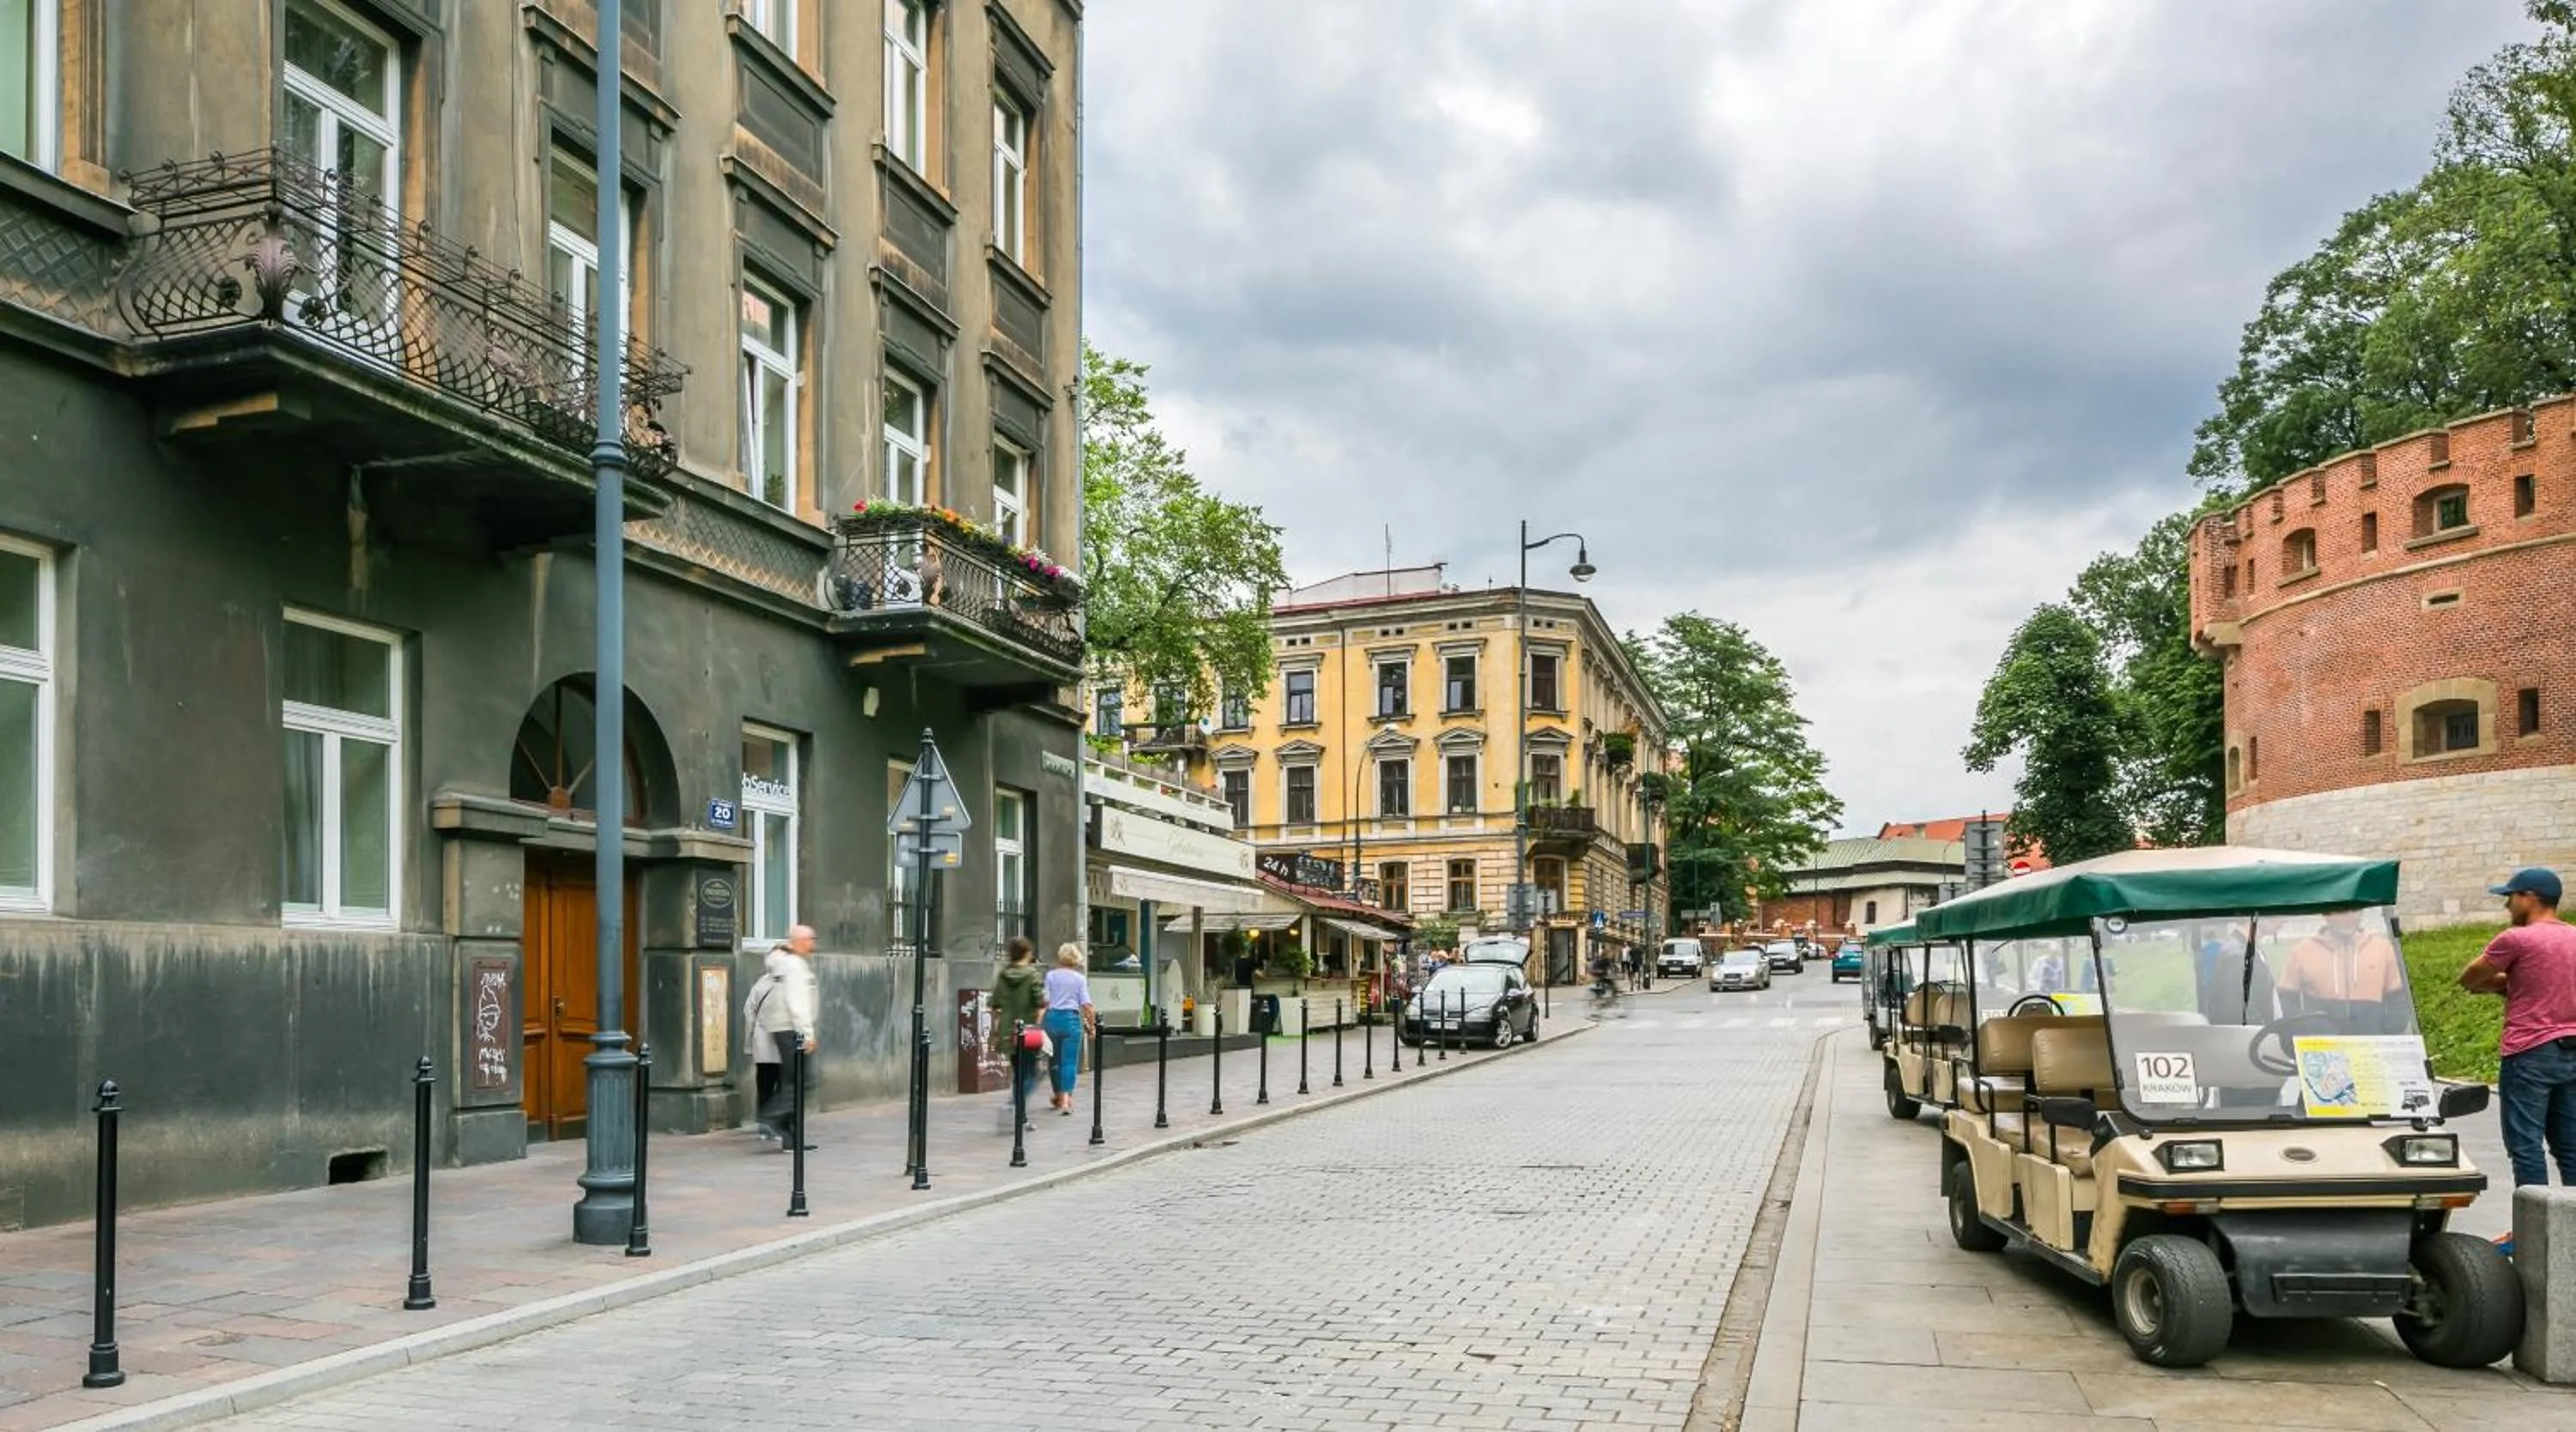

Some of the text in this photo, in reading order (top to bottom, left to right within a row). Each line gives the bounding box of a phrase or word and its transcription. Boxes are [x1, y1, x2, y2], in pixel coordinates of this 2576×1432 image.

[742, 773, 790, 797] bService
[714, 806, 731, 819] 20
[1263, 857, 1279, 871] 24
[1280, 863, 1288, 877] h
[2141, 1057, 2190, 1078] 102
